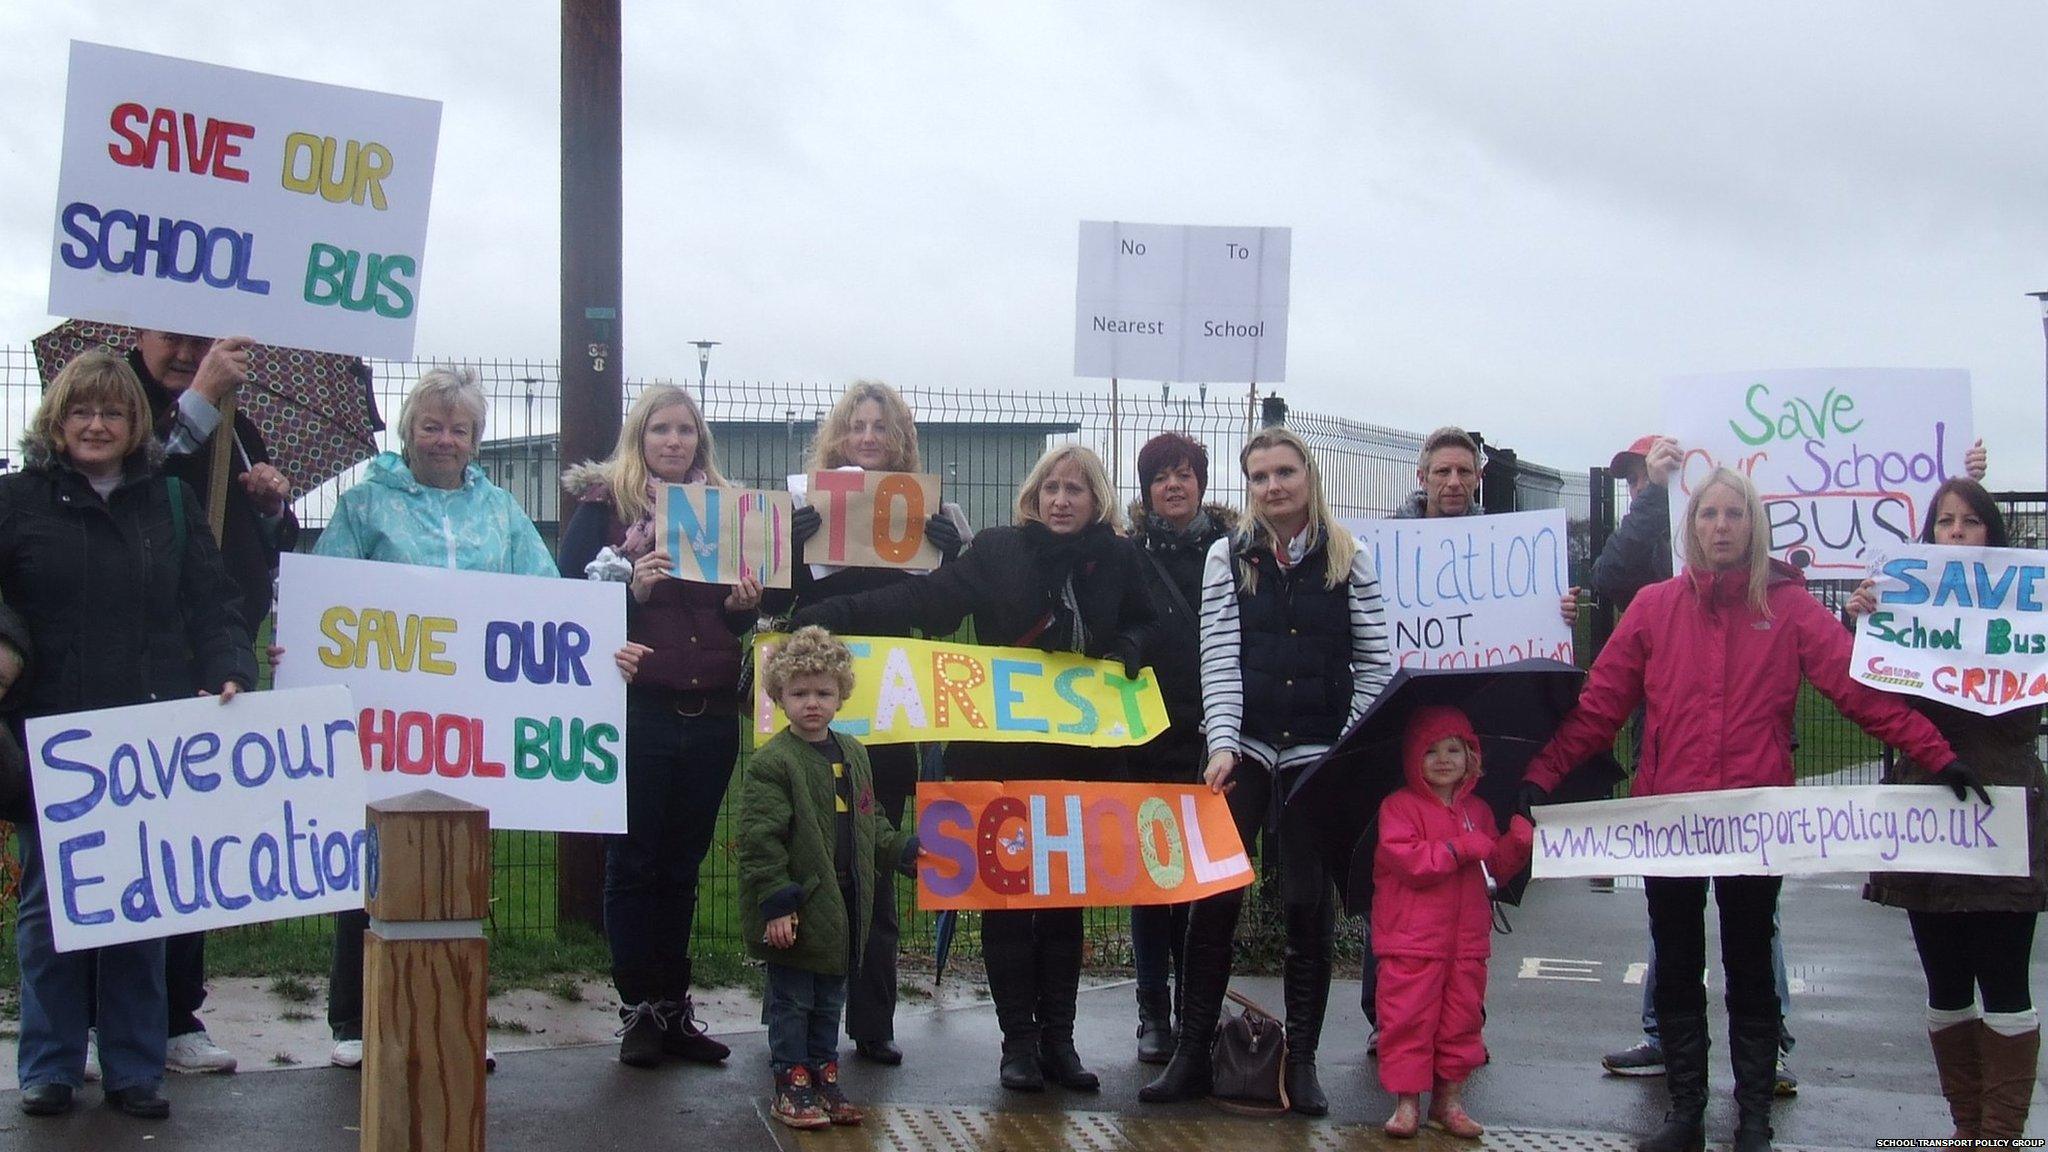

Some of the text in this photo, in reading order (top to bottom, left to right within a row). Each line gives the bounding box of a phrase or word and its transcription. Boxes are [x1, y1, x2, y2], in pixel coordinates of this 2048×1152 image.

[109, 103, 393, 210] SAVE OUR
[60, 202, 415, 318] SCHOOL BUS
[1121, 239, 1249, 260] No To
[1093, 316, 1264, 338] Nearest School
[1729, 384, 1864, 445] Save
[1786, 424, 1948, 494] School
[667, 485, 782, 584] NO
[815, 470, 925, 564] TO
[1881, 558, 2045, 612] SAVE
[318, 607, 591, 686] SAVE OUR
[1396, 613, 1473, 649] NOT
[1866, 611, 2046, 655] School Bus
[42, 719, 356, 822] Save our
[358, 708, 619, 783] HOOL BUS
[919, 794, 1248, 898] SCHOOL
